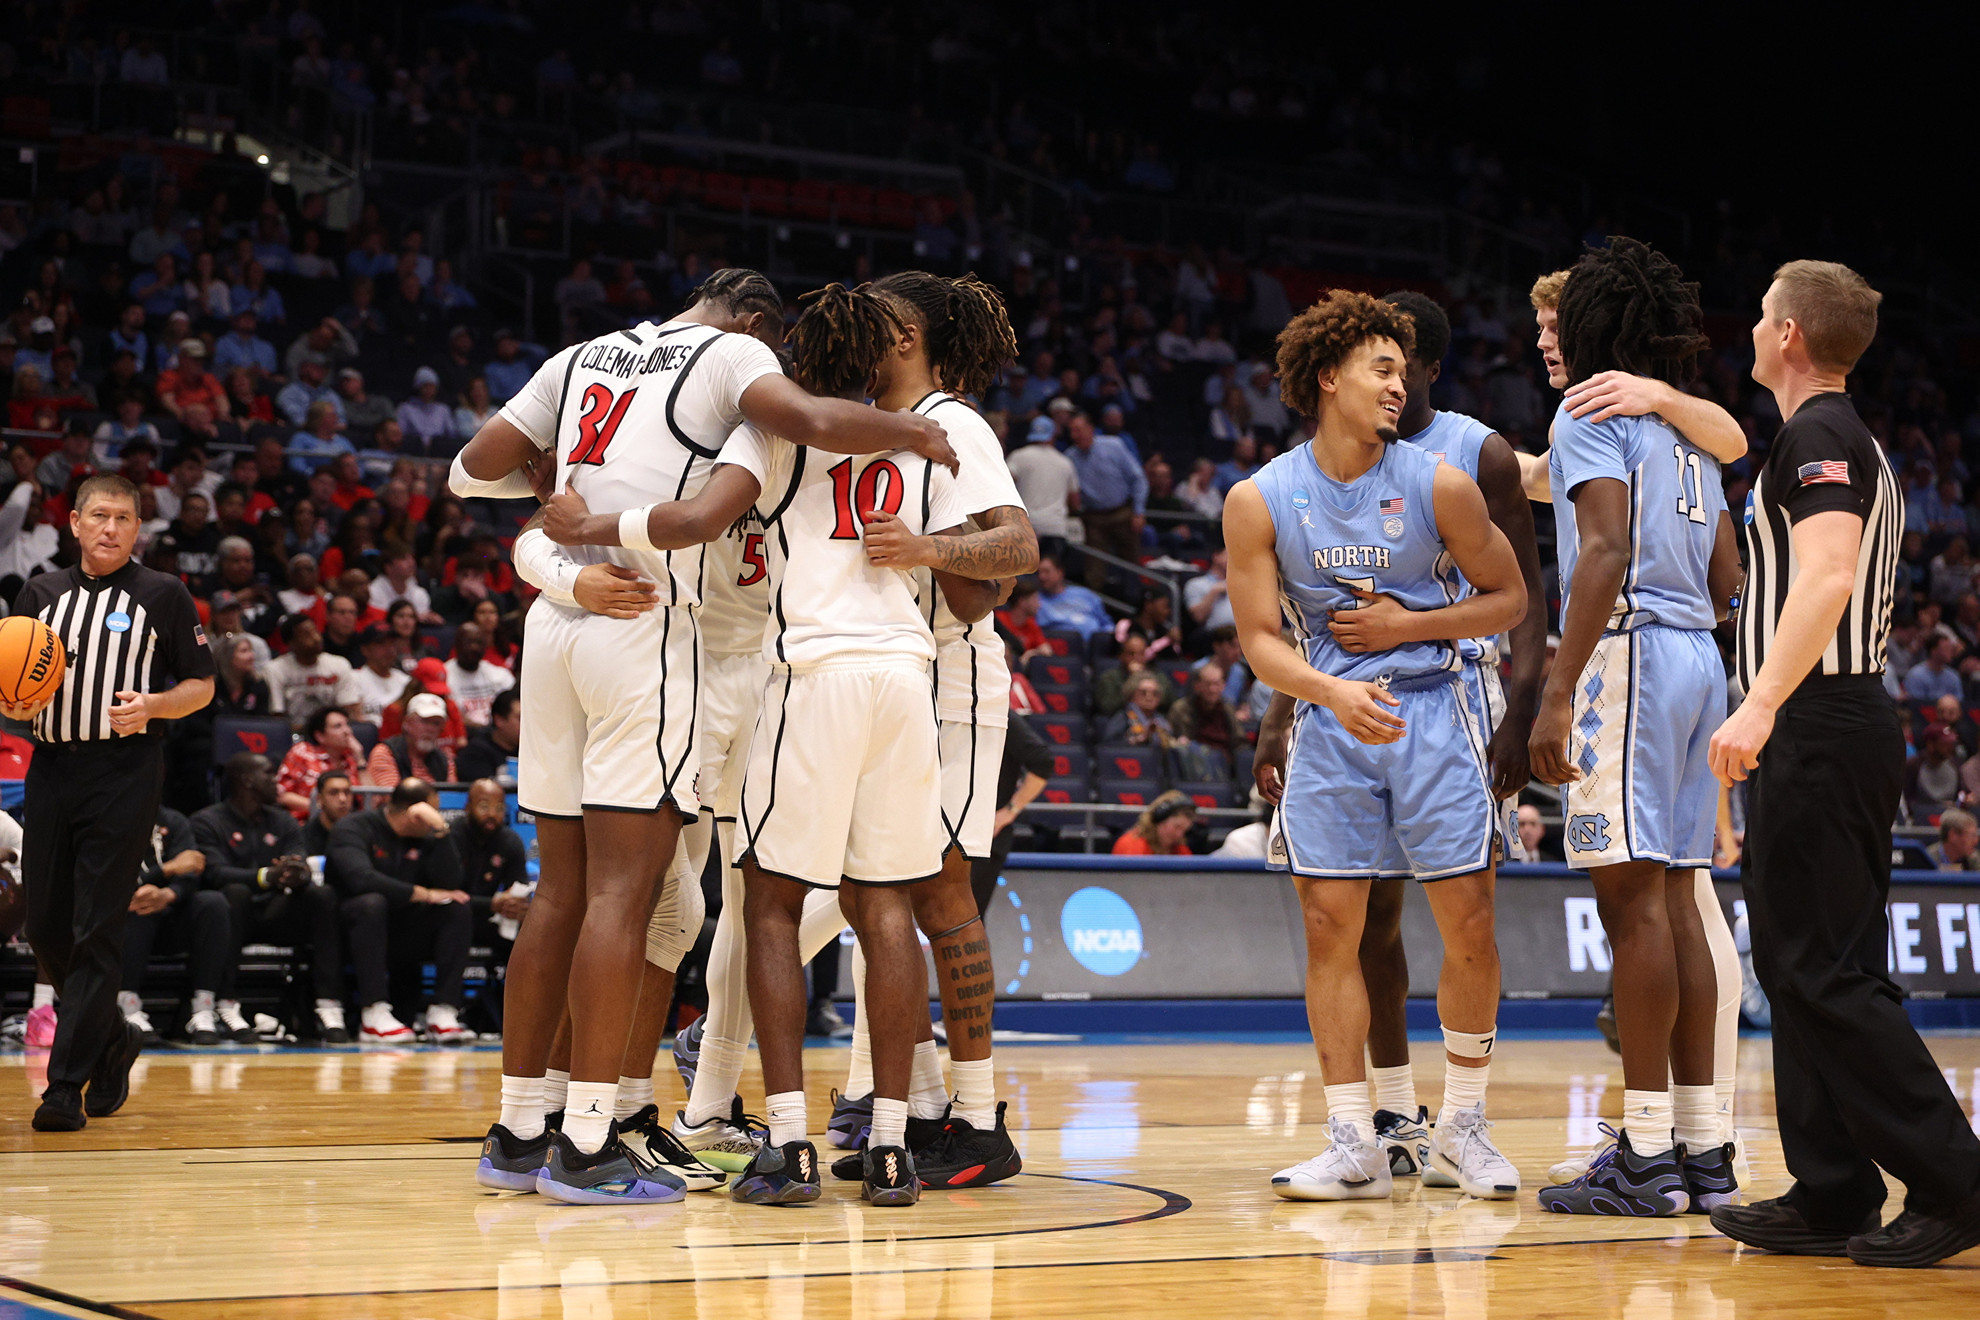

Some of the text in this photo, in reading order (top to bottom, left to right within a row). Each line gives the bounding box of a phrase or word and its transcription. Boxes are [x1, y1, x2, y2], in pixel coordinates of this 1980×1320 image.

[566, 382, 640, 466] 31
[827, 456, 904, 540] 10
[1673, 443, 1707, 526] 11
[737, 533, 767, 586] 5
[1313, 545, 1391, 570] NORTH
[28, 629, 54, 683] Wilson
[1073, 928, 1142, 953] NCAA
[1480, 1036, 1494, 1054] 7
